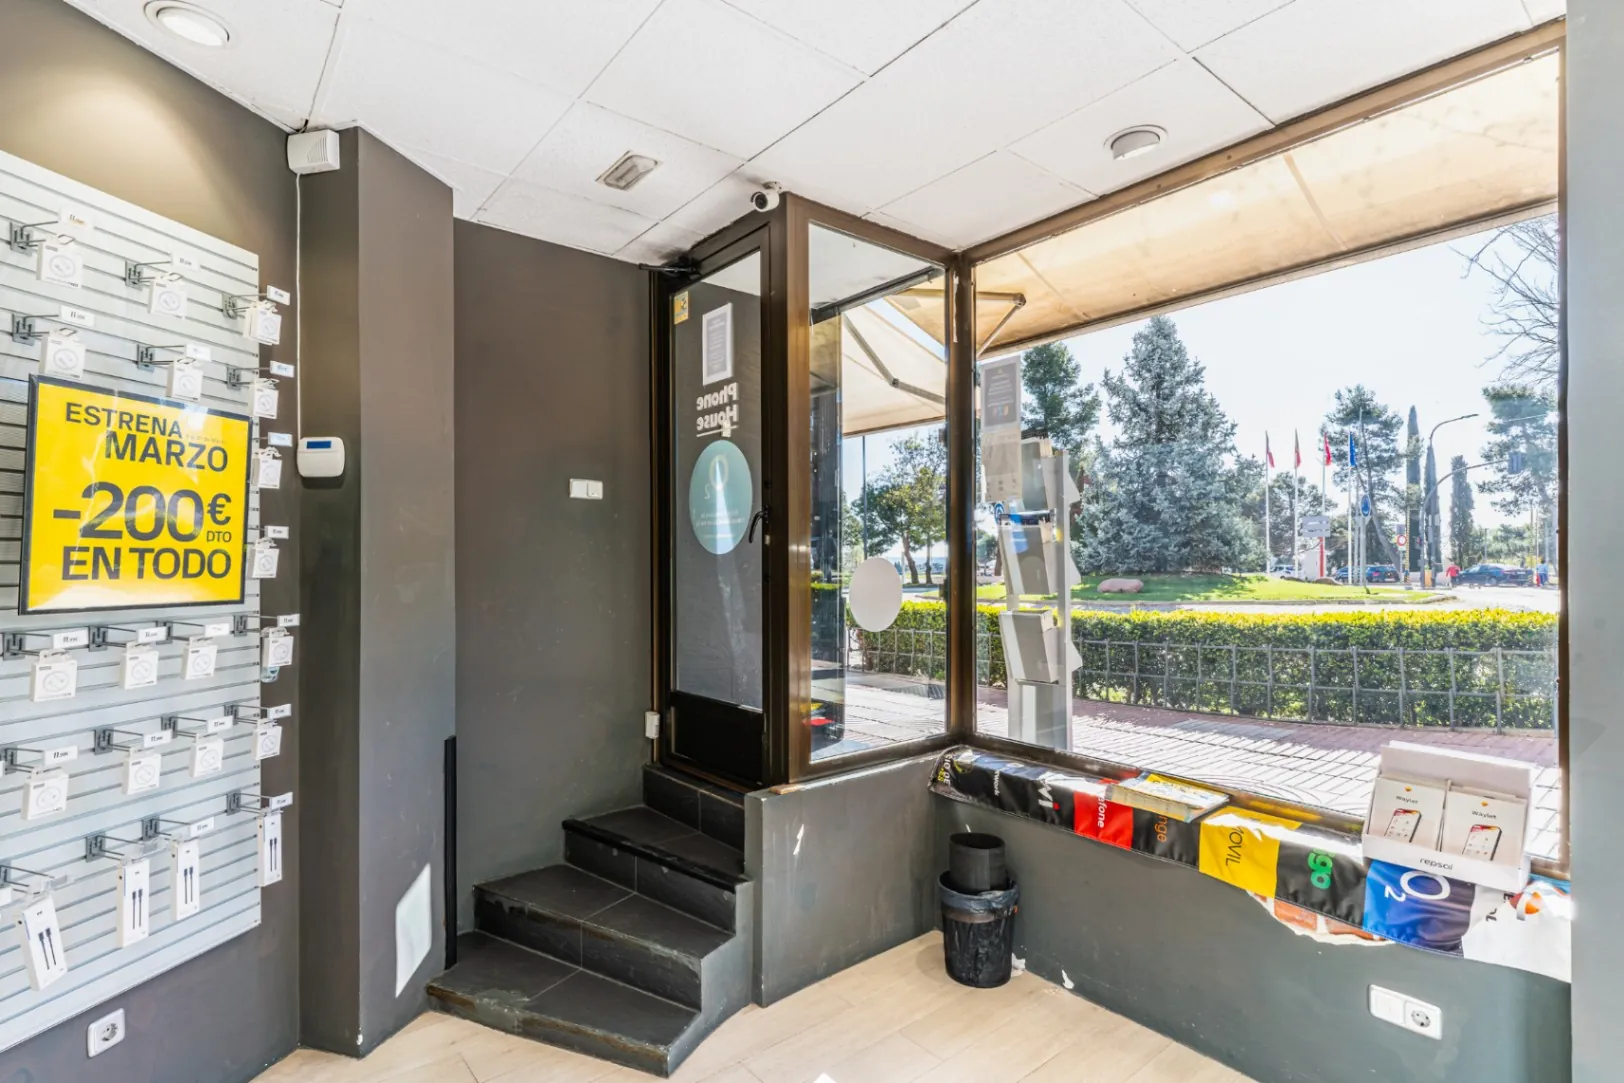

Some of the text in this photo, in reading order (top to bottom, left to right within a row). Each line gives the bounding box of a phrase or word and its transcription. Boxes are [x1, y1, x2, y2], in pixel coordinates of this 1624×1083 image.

[65, 402, 182, 439] ESTRENA
[105, 430, 229, 472] MARZO
[206, 530, 232, 543] DTO
[61, 546, 232, 580] EN TODO
[1419, 857, 1453, 870] repsol
